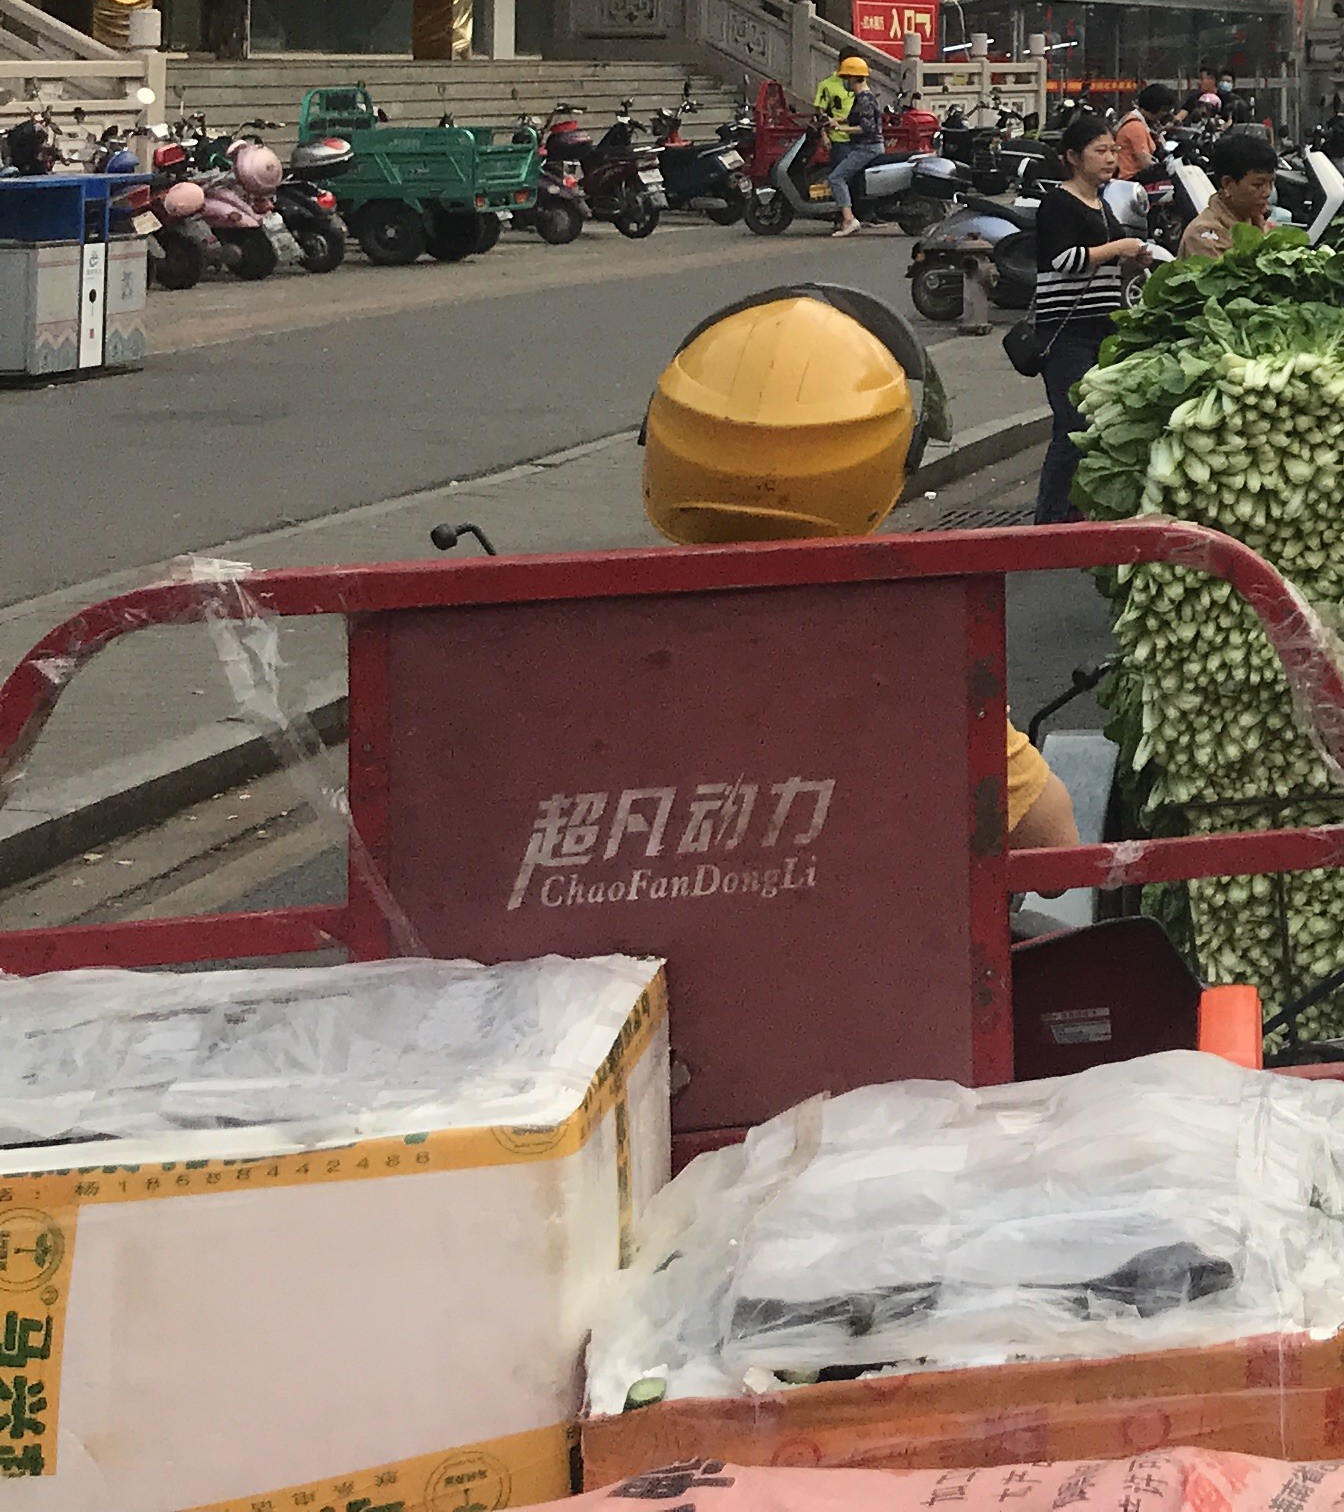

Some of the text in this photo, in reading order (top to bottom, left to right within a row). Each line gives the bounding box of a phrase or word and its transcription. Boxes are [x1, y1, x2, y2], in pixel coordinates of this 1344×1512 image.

[508, 773, 835, 909] 超凡动力
[540, 856, 818, 909] ChaoFanDongLi
